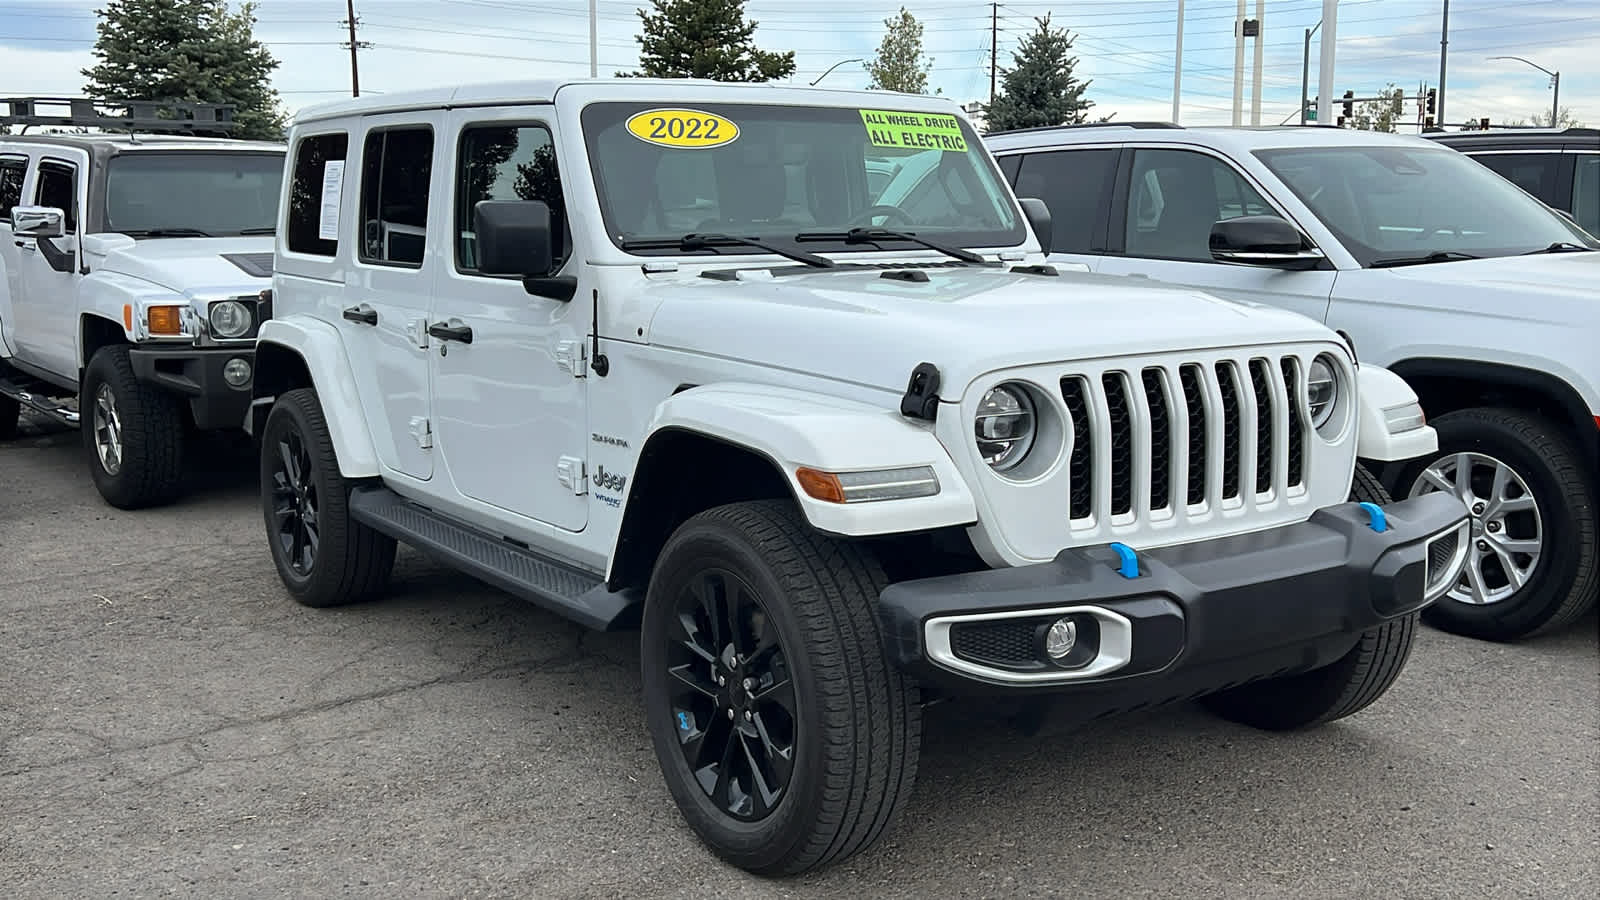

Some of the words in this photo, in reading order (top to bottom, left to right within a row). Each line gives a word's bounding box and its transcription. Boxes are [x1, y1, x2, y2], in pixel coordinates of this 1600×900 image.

[649, 117, 720, 139] 2022
[865, 114, 885, 124] ALL
[885, 115, 923, 127] WHEEL
[923, 117, 957, 129] DRIVE
[872, 130, 897, 145] ALL
[901, 131, 965, 150] ELECTRIC
[592, 433, 629, 448] SAHARA
